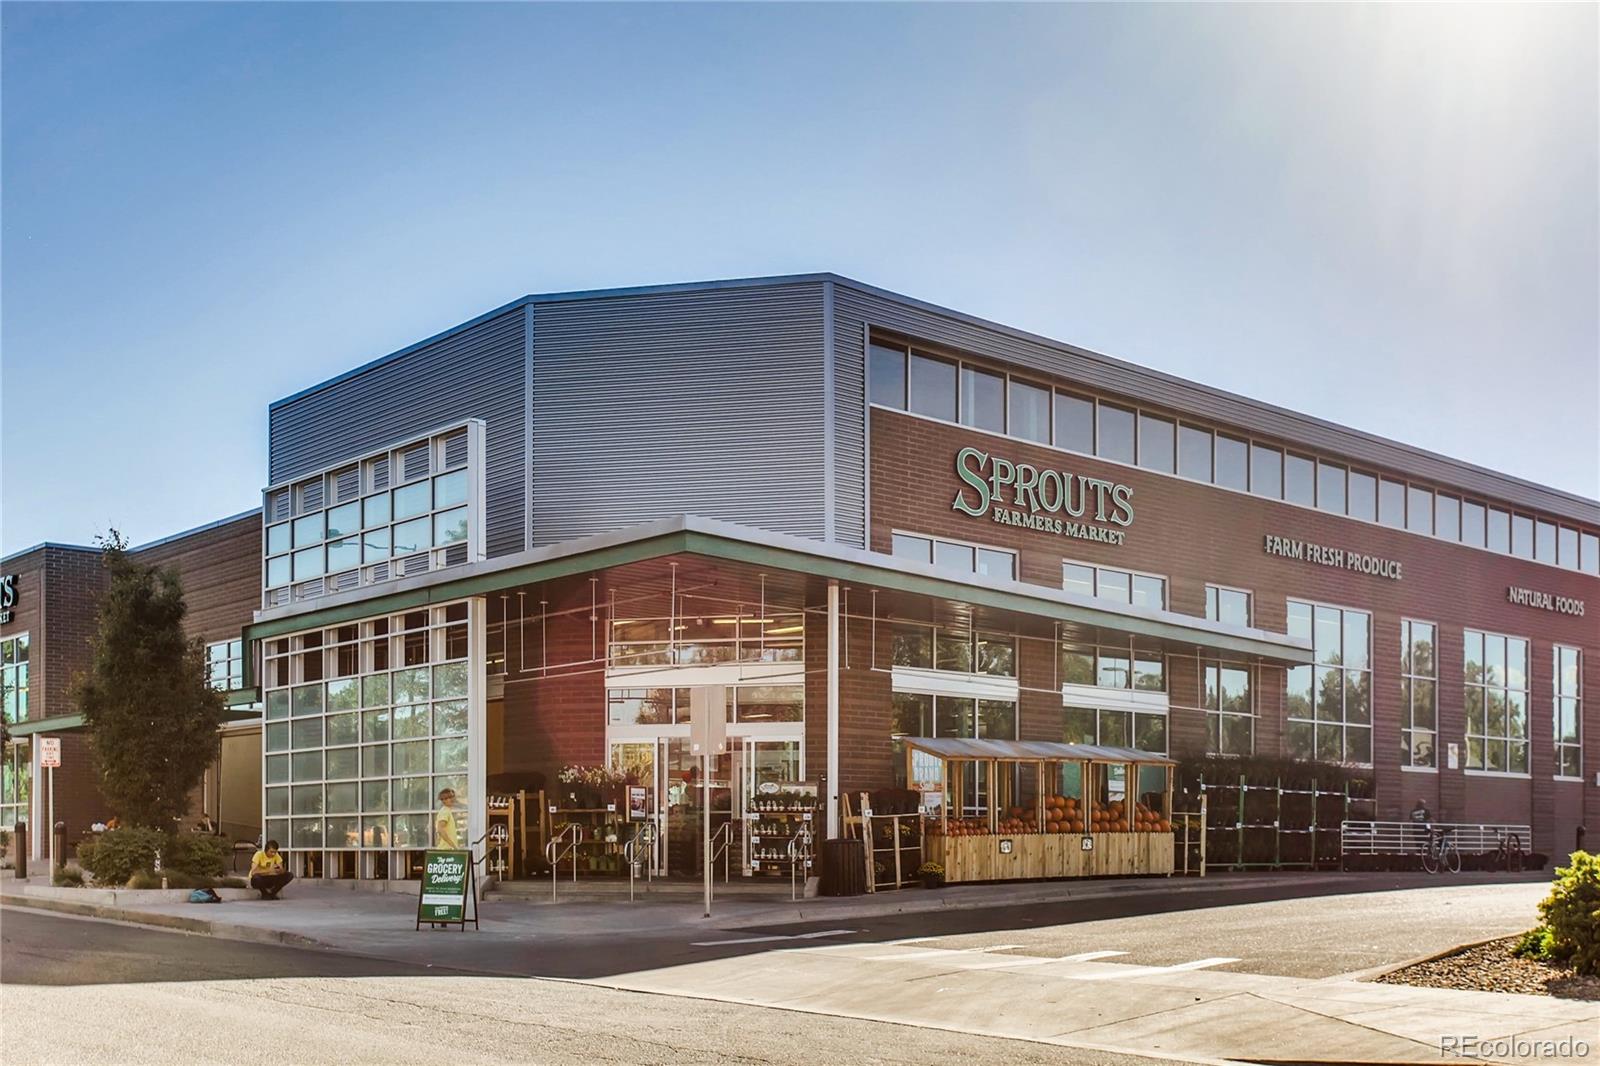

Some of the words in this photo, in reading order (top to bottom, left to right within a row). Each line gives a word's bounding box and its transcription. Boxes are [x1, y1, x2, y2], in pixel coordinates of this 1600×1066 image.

[953, 447, 1134, 526] SPROUTS
[993, 507, 1062, 534] FARMERS
[1065, 521, 1125, 545] MARKET
[1266, 535, 1303, 560] FARM
[1306, 543, 1344, 568] FRESH
[1347, 552, 1402, 580] PRODUCE
[1509, 586, 1554, 611] NATURAL
[1556, 596, 1585, 617] FOODS
[427, 863, 463, 874] GROCERY
[431, 872, 465, 884] Delivery!
